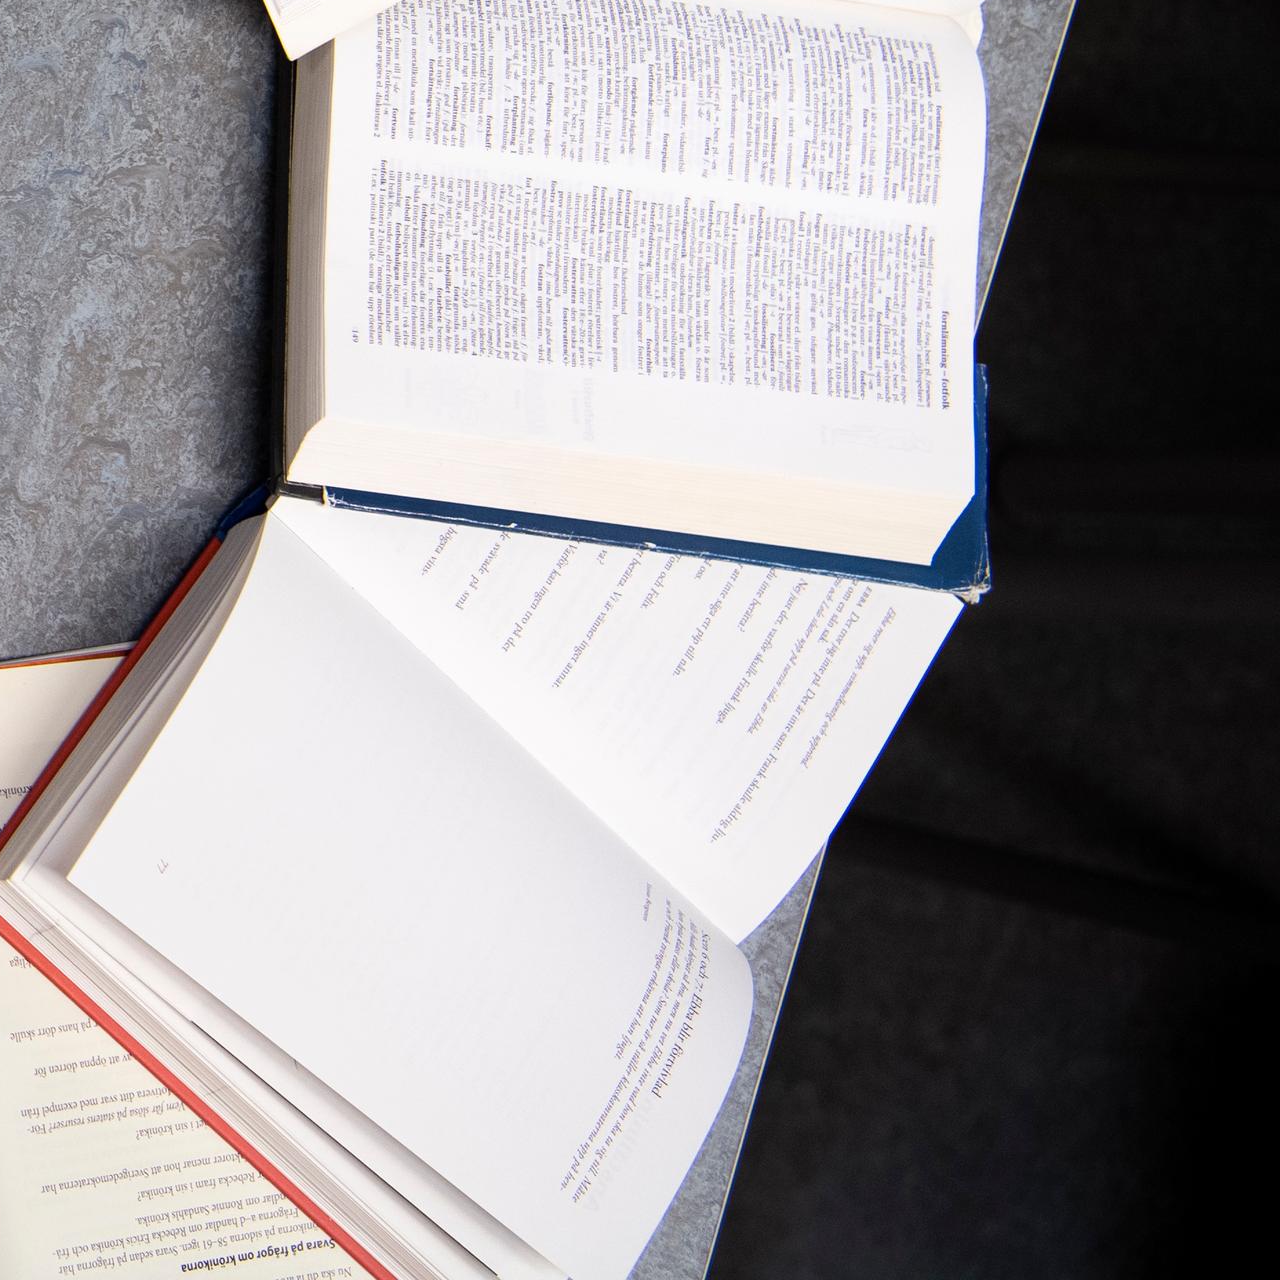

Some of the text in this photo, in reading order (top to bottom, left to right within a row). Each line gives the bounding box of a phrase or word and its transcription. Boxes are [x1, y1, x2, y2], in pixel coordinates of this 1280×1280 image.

[939, 310, 950, 369] fornlämning
[941, 378, 951, 410] fotfolk
[258, 1204, 300, 1221] Frågorna
[188, 1223, 203, 1234] om
[204, 1217, 240, 1233] handlar
[239, 1214, 257, 1228] a–d
[125, 1233, 151, 1247] Ericis
[151, 1226, 187, 1243] Rebecka
[71, 1244, 90, 1258] och
[90, 1238, 126, 1254] krönika
[180, 1237, 336, 1273] Svara på frågor om krönikorna
